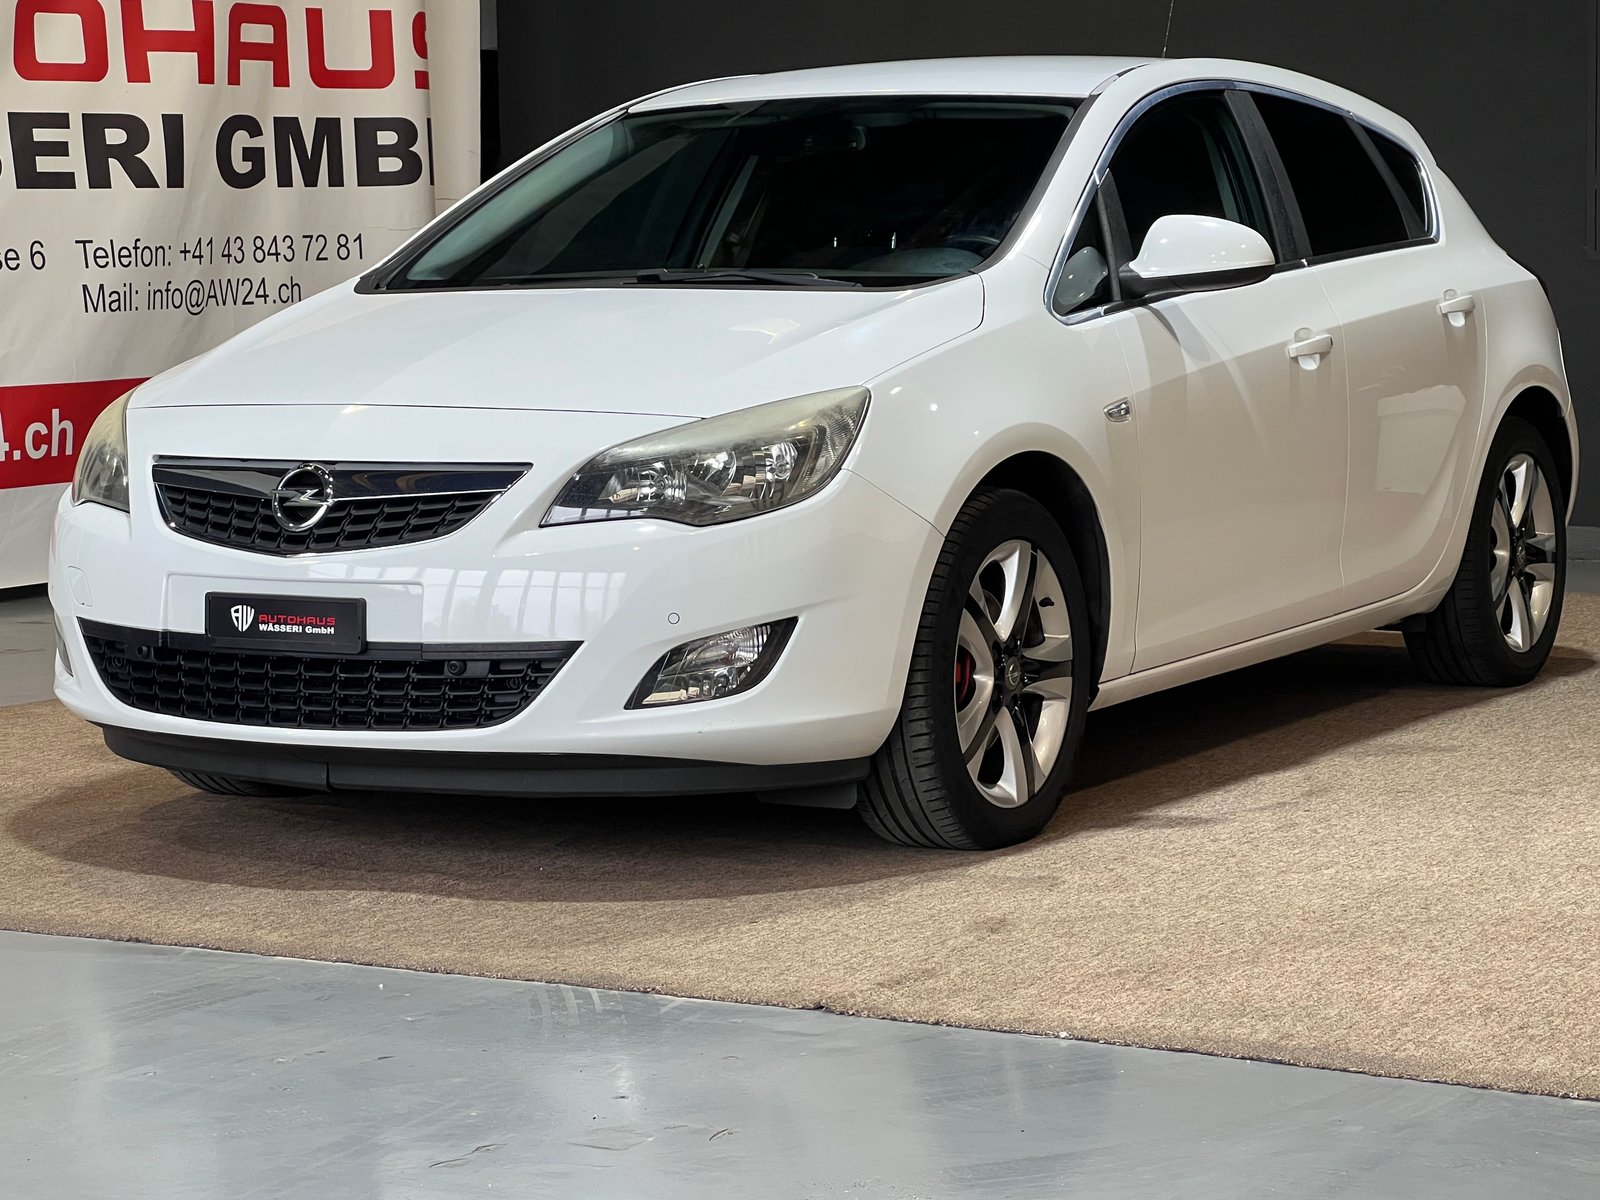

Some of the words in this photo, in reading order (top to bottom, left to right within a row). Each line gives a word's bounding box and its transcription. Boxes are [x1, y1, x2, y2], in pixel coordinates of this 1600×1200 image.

[0, 111, 184, 190] ERI
[215, 114, 434, 190] GMB
[0, 248, 20, 271] e
[30, 240, 46, 270] 6
[75, 238, 171, 269] Telefon:
[179, 236, 213, 265] +41
[221, 235, 245, 264] 43
[252, 234, 295, 263] 843
[302, 233, 328, 262] 72
[336, 232, 364, 260] 81
[81, 282, 139, 313] Mail:
[147, 276, 302, 316] info@AW24.ch
[258, 614, 336, 626] AUTOHAUS
[258, 622, 303, 634] WÄSSERI
[305, 625, 335, 635] GmbH
